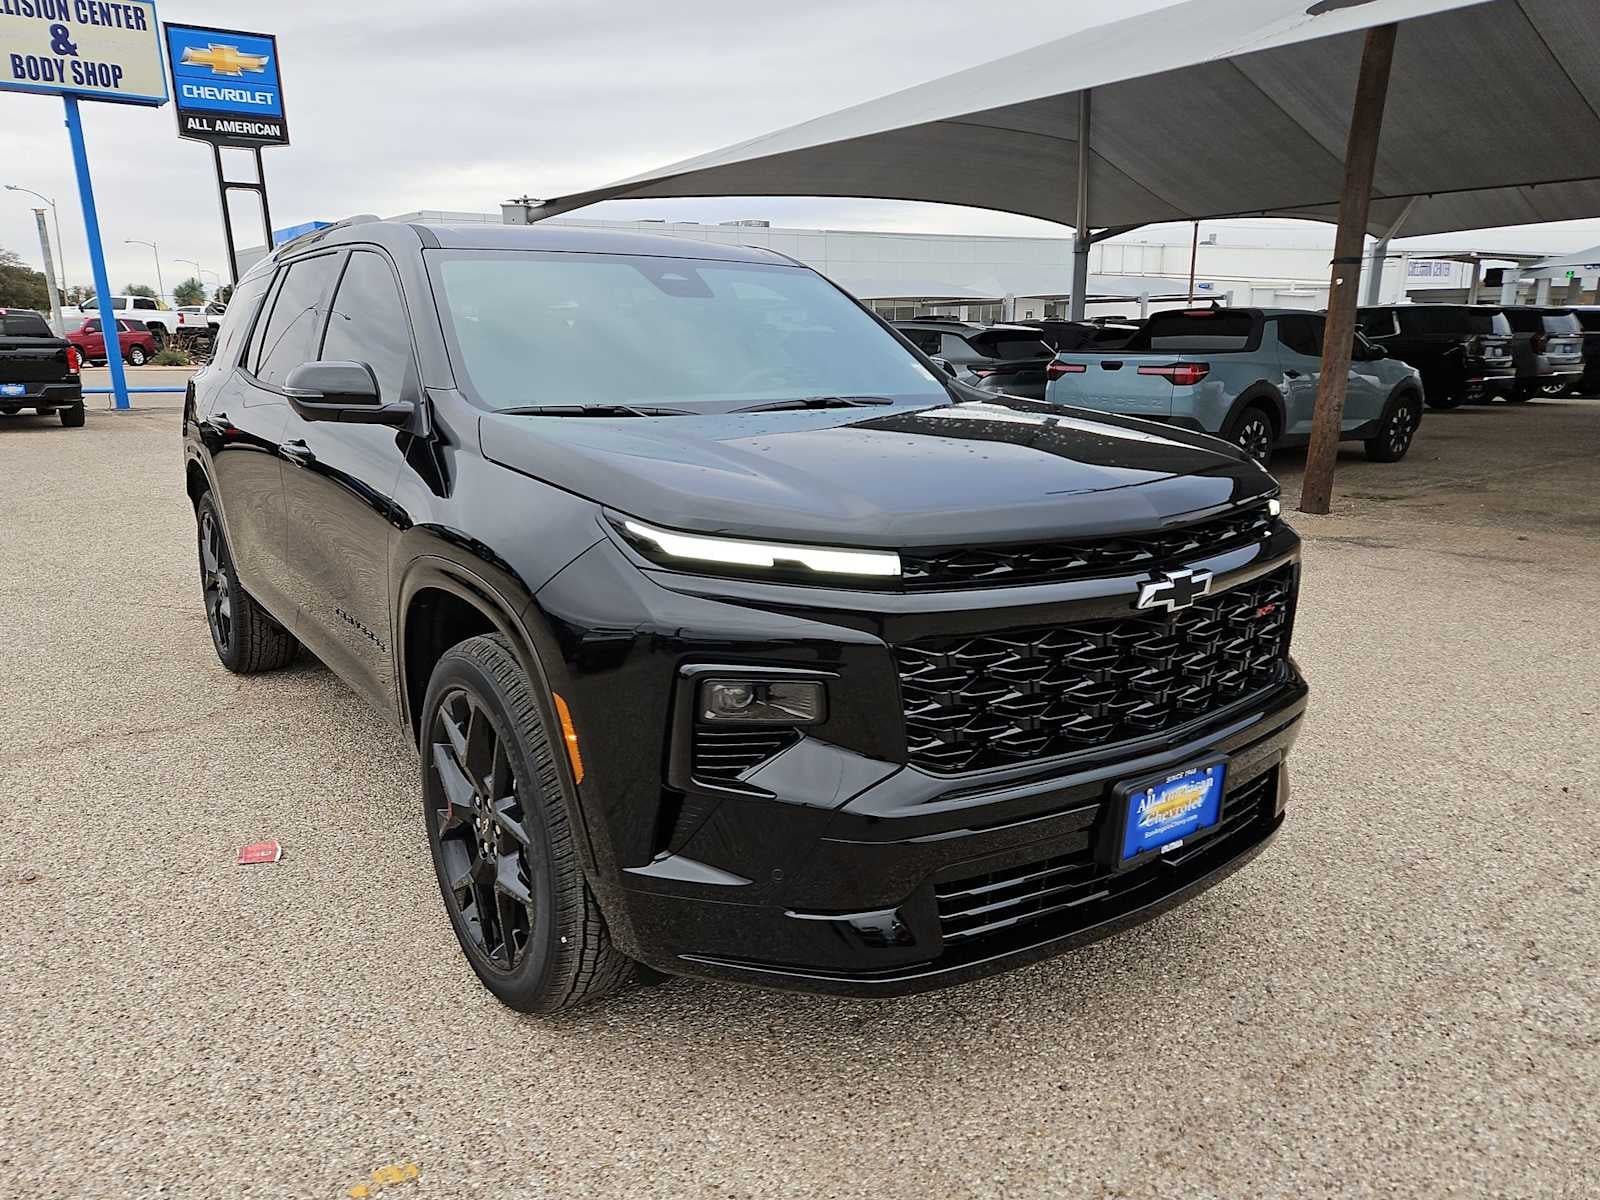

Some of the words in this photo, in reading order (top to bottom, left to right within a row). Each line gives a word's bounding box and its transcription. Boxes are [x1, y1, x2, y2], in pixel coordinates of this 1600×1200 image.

[0, 0, 70, 22] LISION
[75, 0, 147, 31] CENTER
[49, 23, 79, 57] &
[10, 53, 65, 83] BODY
[71, 60, 123, 89] SHOP
[182, 84, 273, 105] CHEVROLET
[187, 117, 212, 131] ALL
[215, 120, 280, 137] AMERICAN
